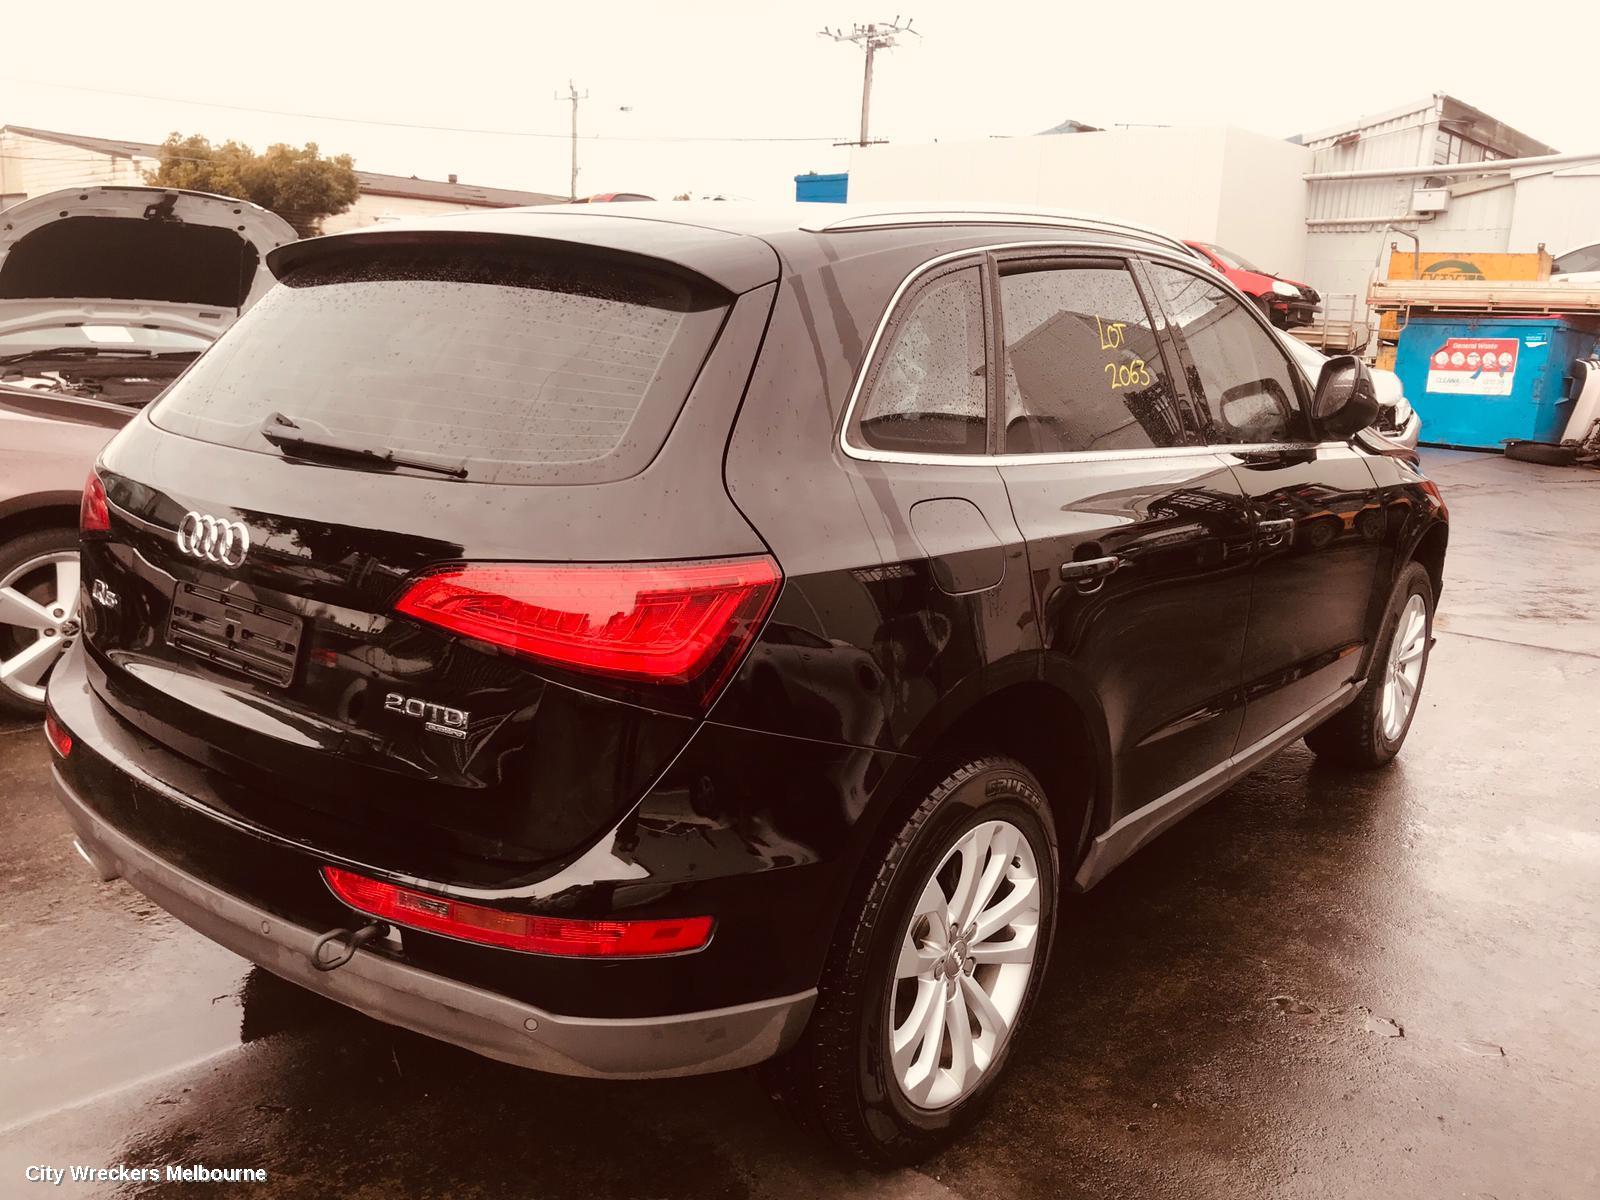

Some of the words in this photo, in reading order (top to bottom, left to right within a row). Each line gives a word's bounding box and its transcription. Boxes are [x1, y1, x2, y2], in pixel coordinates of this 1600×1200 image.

[1095, 314, 1127, 350] LOT
[1452, 342, 1477, 350] General
[1477, 342, 1499, 350] Waste
[1104, 359, 1151, 390] 2063
